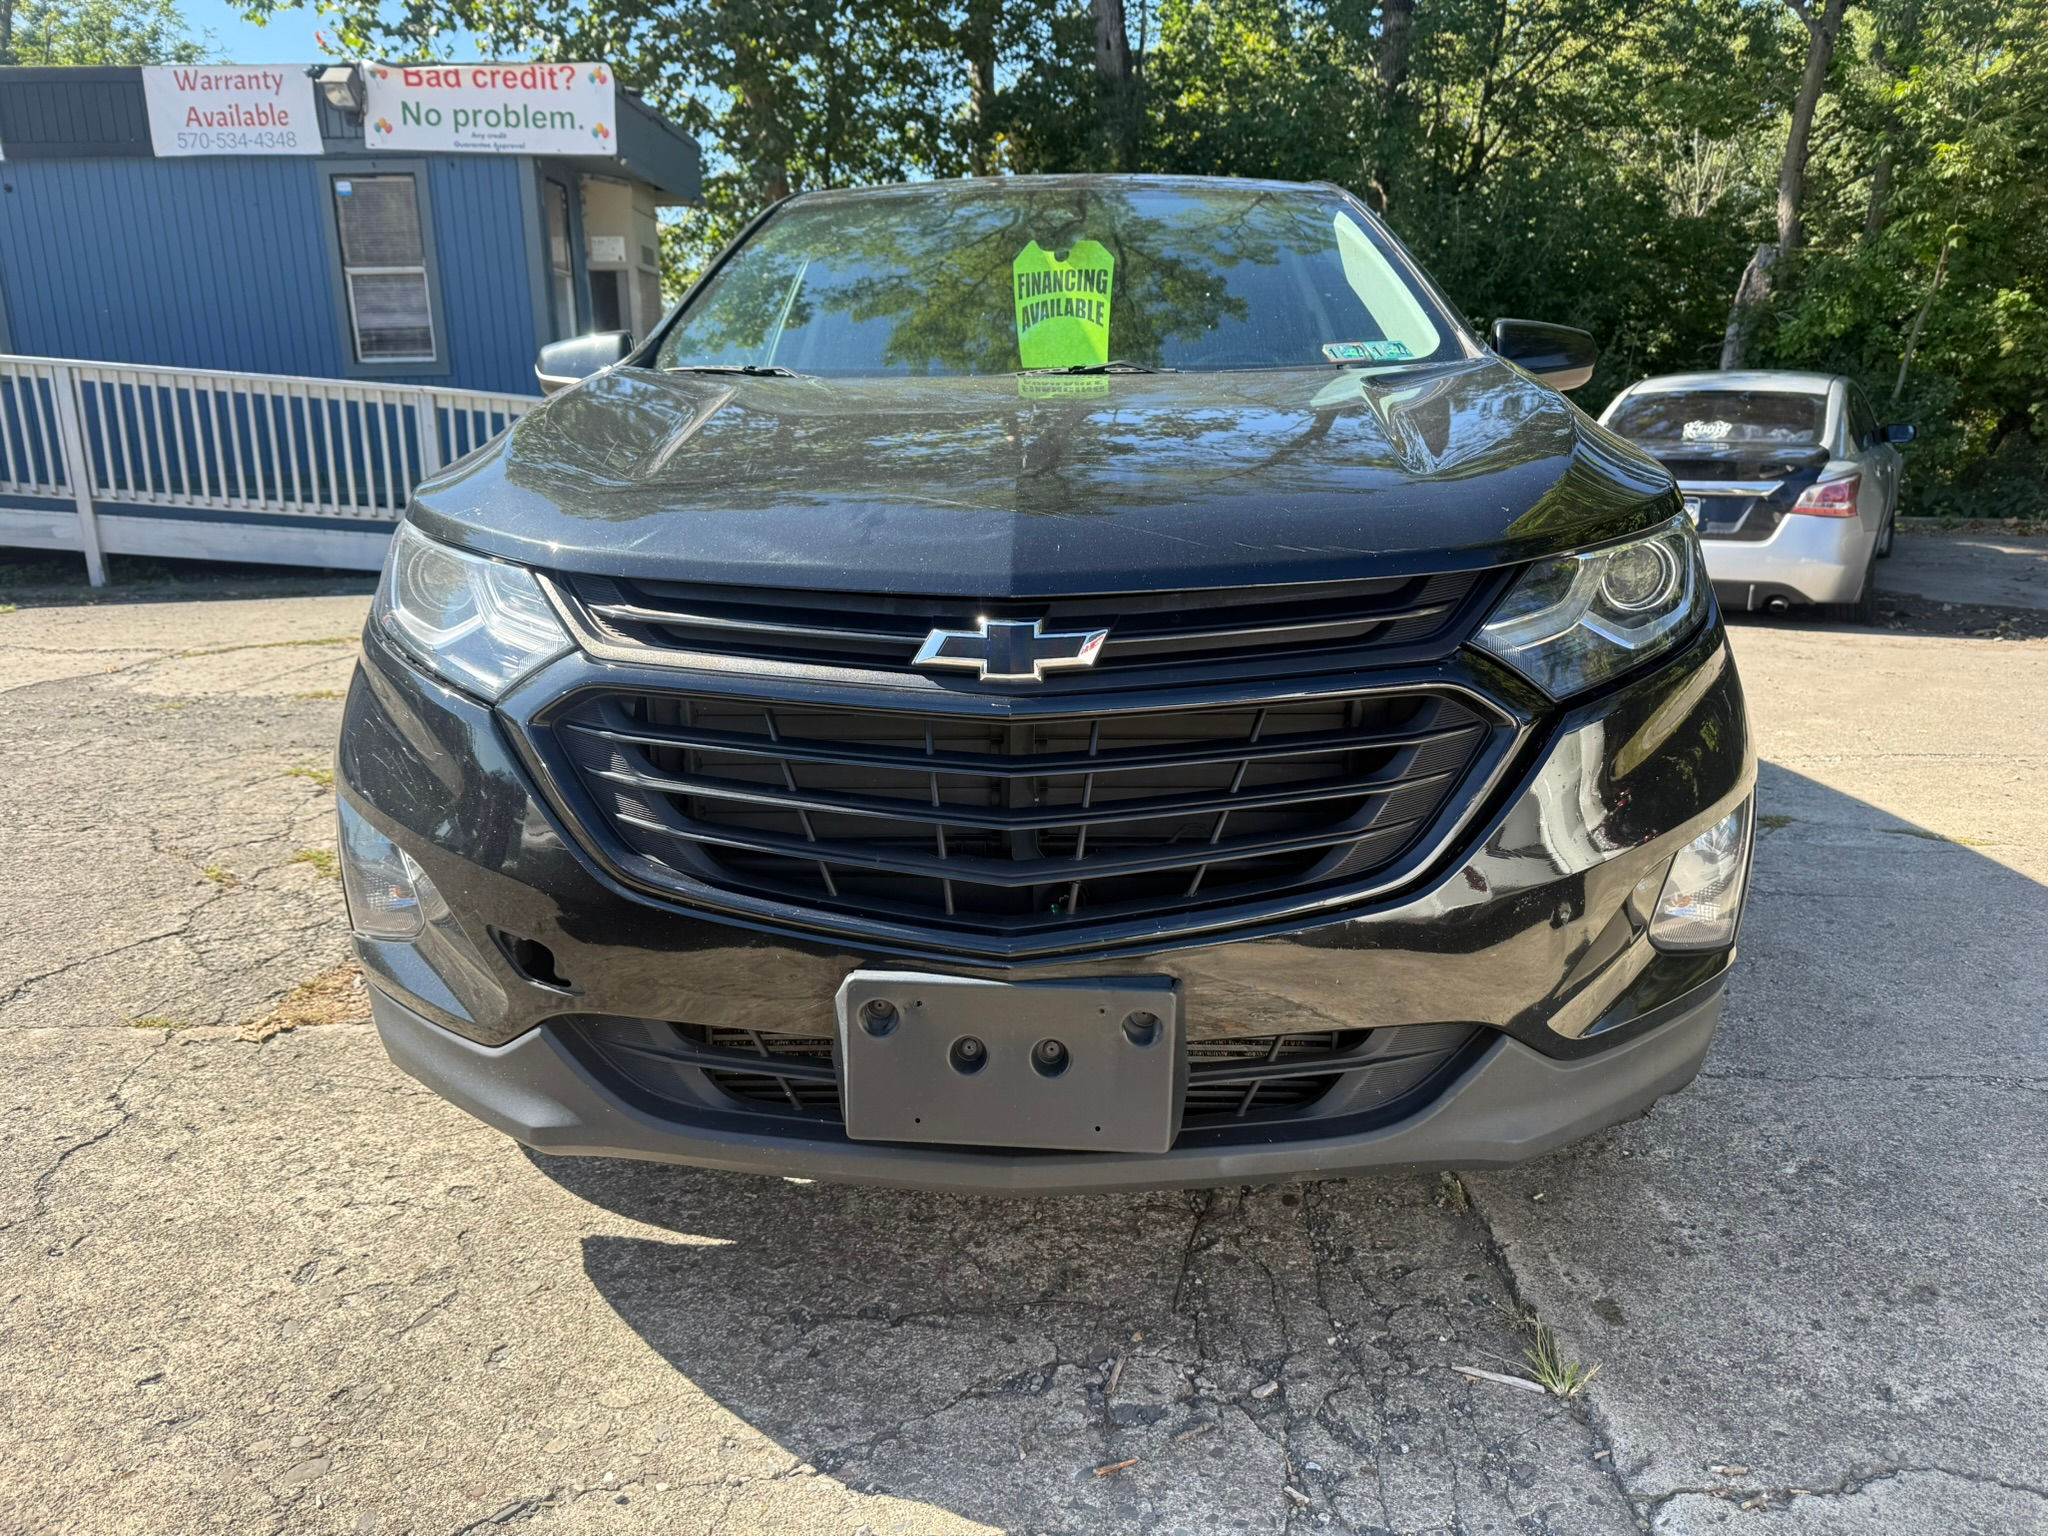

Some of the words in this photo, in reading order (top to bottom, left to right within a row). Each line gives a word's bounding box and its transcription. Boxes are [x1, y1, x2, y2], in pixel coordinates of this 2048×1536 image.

[173, 69, 284, 96] Warranty
[402, 67, 462, 88] Bad
[471, 65, 576, 91] credit?
[185, 102, 290, 128] Available
[401, 101, 442, 127] No
[453, 103, 585, 134] problem.
[176, 131, 298, 150] 570-534-4348
[1017, 268, 1109, 300] FINANCING
[1021, 297, 1105, 334] AVAILABLE
